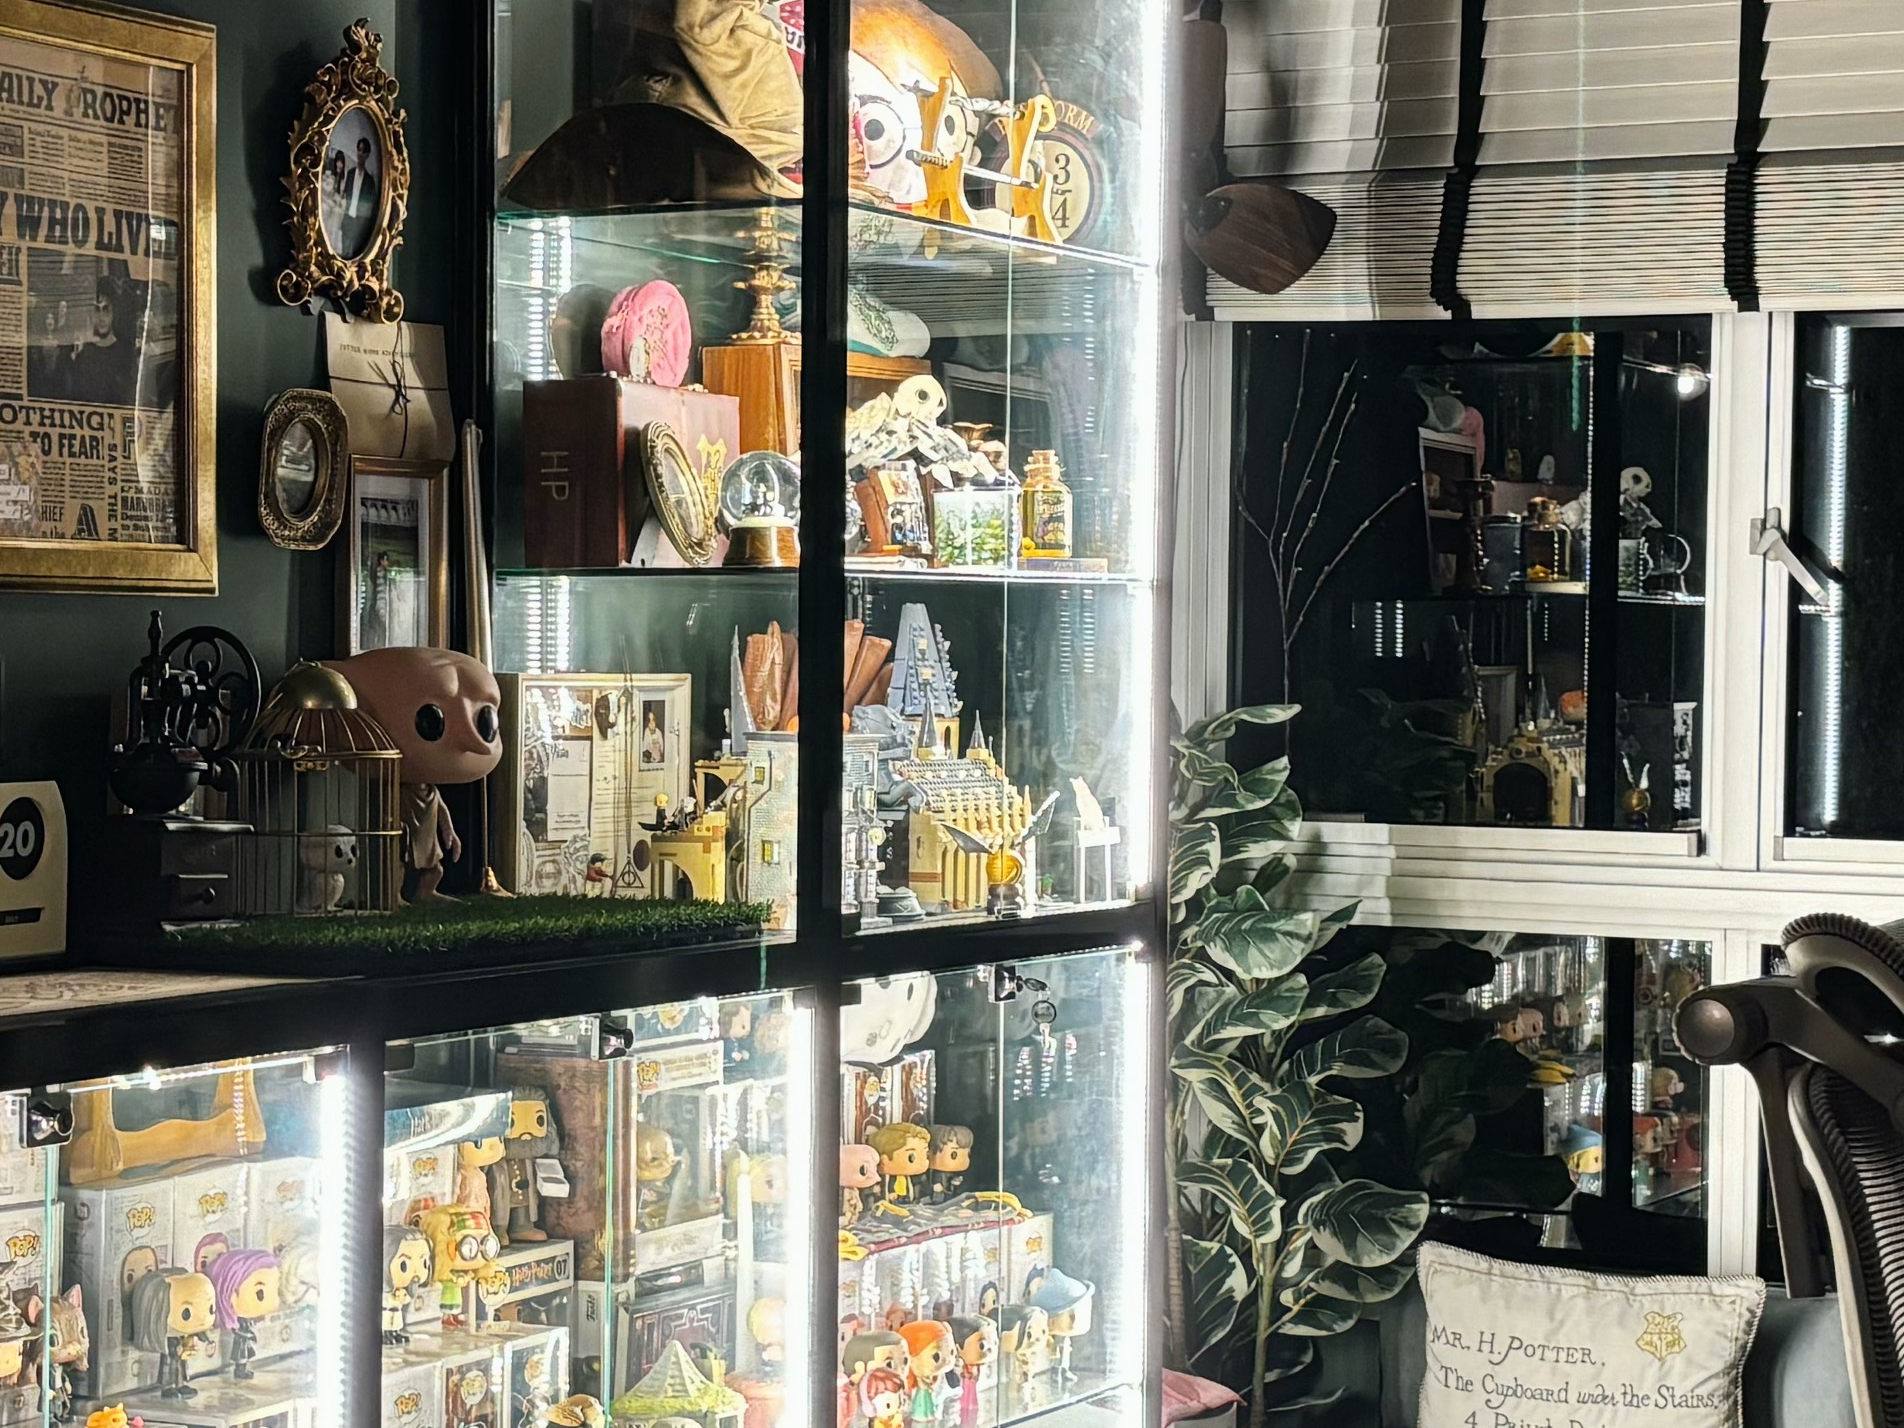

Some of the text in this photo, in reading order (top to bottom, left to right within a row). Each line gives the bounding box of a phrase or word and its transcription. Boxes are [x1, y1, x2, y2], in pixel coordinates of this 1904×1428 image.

[13, 192, 90, 250] WHO
[29, 430, 105, 461] TO FEAR!
[5, 1234, 40, 1260] POP!
[1430, 1324, 1471, 1353] MR.
[1477, 1329, 1502, 1356] H.
[1439, 1364, 1475, 1394] The
[1575, 1382, 1621, 1407] under
[1621, 1383, 1651, 1408] the
